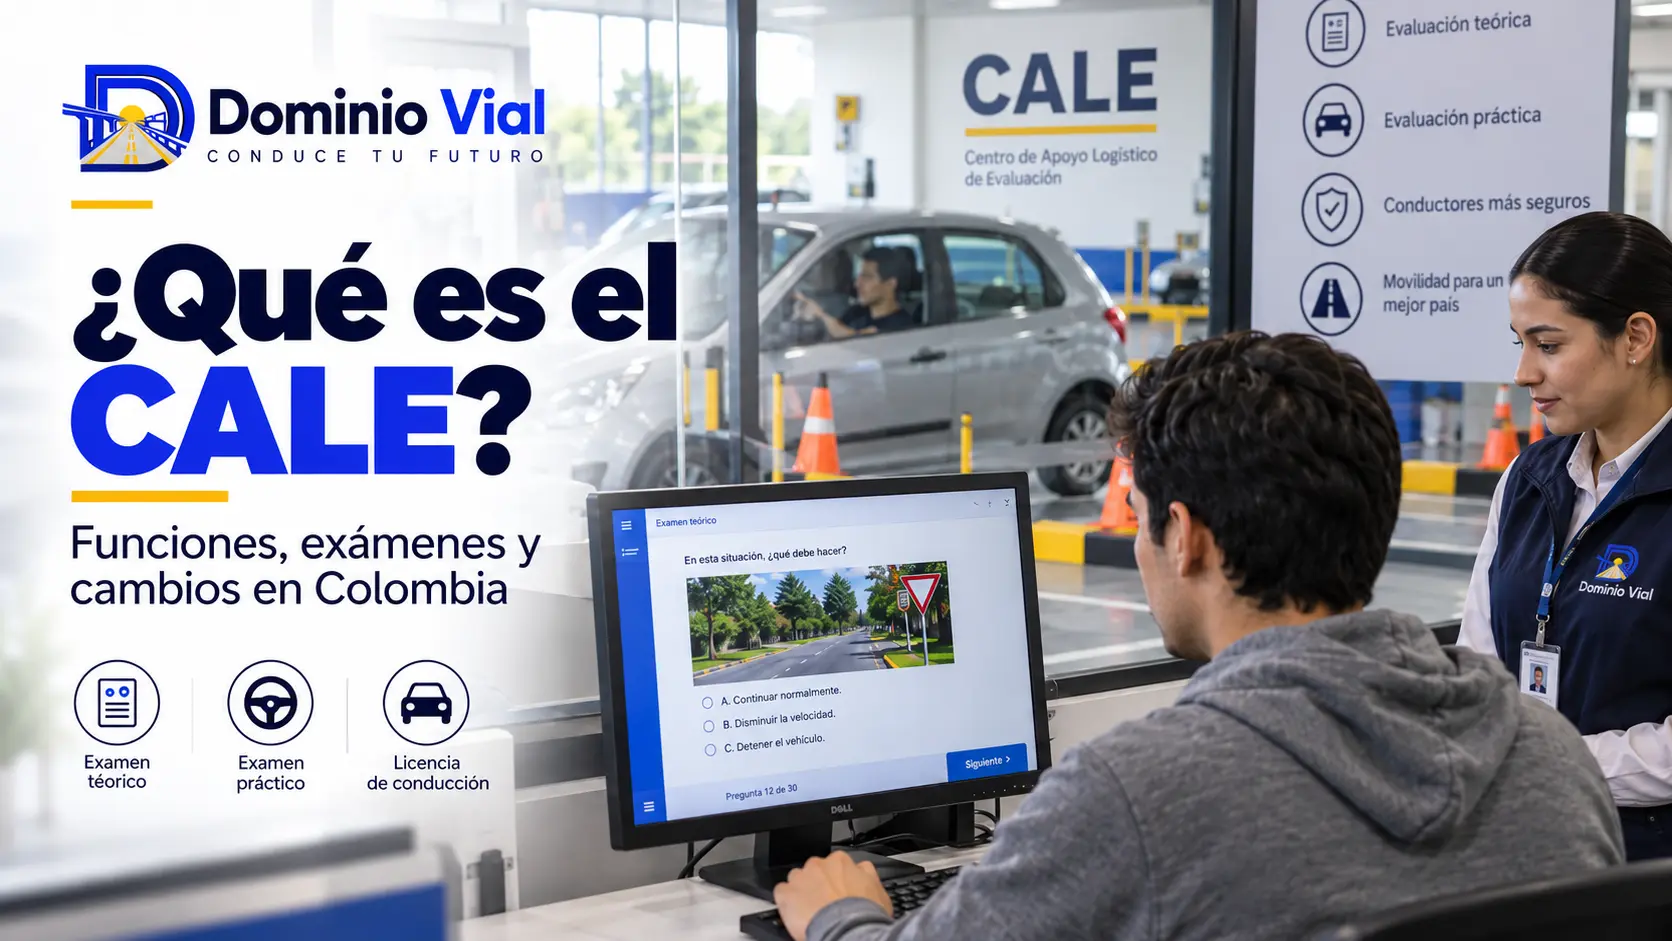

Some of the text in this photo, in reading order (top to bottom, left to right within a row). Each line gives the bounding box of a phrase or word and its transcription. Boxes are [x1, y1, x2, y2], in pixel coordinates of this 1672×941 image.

[1385, 12, 1532, 38] Evaluación teórica
[963, 47, 1158, 116] CALE
[1384, 105, 1542, 129] Evaluación práctica
[964, 146, 1158, 167] Centro de Apoyo Logístico
[964, 169, 1062, 187] de Evaluación
[1383, 193, 1591, 214] Conductores más seguros
[1383, 272, 1504, 292] Movilidad para un
[1383, 296, 1460, 316] mejor país
[655, 516, 717, 528] Examen teórico
[684, 545, 847, 566] En esta situación, ¿qué debe hacer?
[1578, 580, 1654, 602] Dominio Vial
[721, 686, 842, 706] A. Continuar normalmente.
[723, 709, 836, 730] B. Disminuir la velocidad.
[724, 733, 826, 754] C. Detener el vehículo.
[965, 756, 1003, 771] Siguiente
[725, 783, 798, 802] Pregunta 12 de 30
